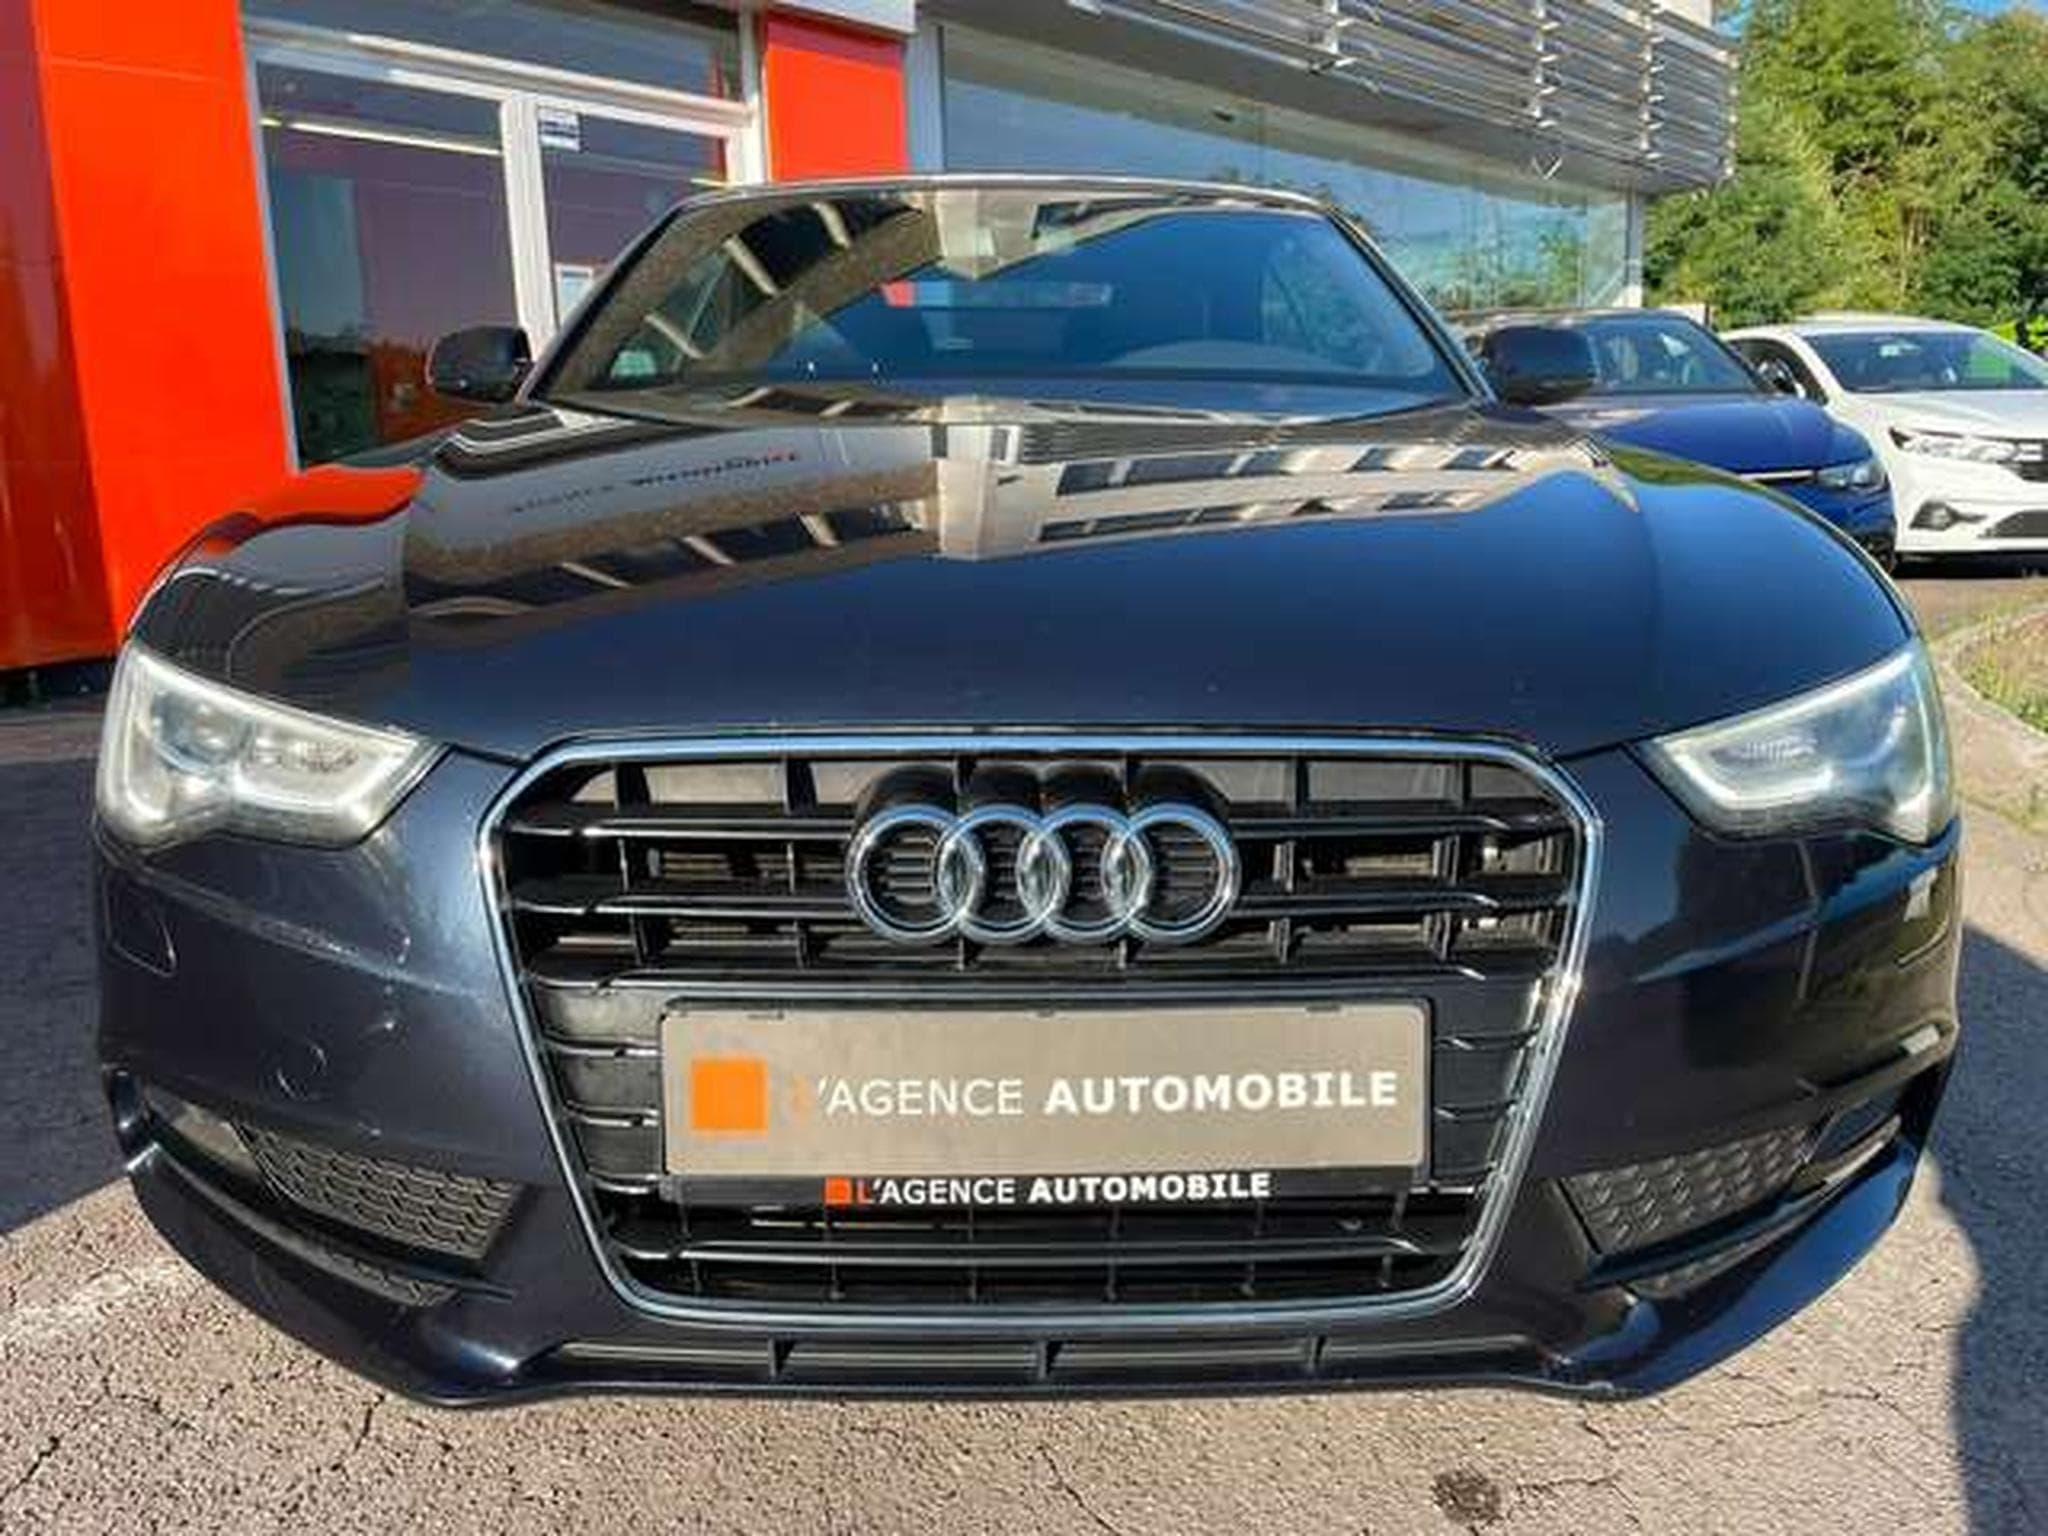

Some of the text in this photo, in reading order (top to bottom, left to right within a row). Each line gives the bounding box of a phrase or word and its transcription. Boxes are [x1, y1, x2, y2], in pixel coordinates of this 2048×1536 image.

[789, 1071, 1398, 1116] 'AGENCE AUTOMOBILE
[857, 1173, 1271, 1204] L'AGENCE AUTOMOBILE
